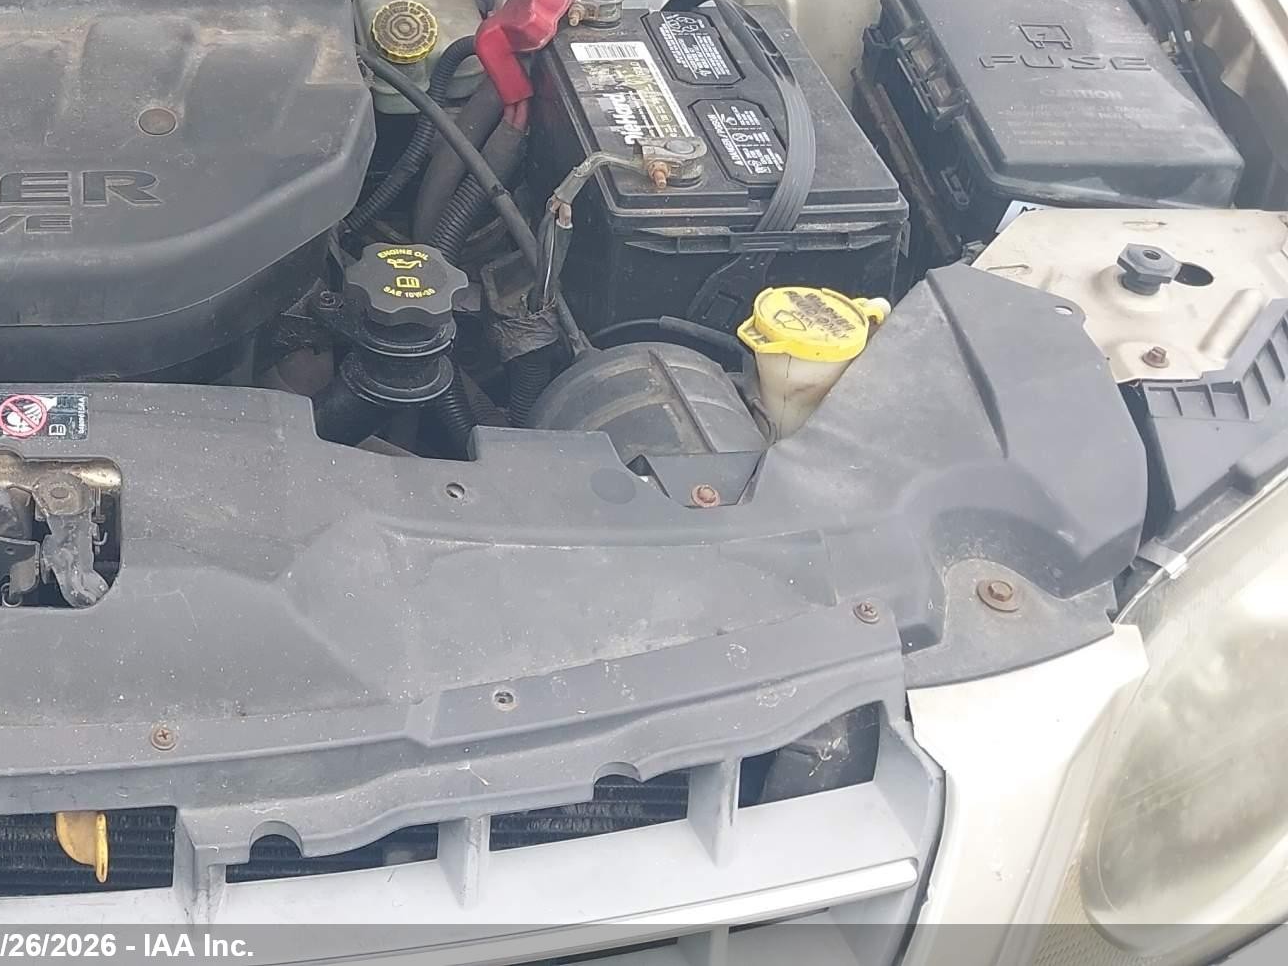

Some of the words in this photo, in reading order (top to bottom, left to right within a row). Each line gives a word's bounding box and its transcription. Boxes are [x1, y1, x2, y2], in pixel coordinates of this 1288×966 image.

[979, 55, 1152, 70] FUSE
[377, 249, 412, 259] ENGINE
[414, 251, 428, 260] OIL
[383, 286, 402, 297] SAE
